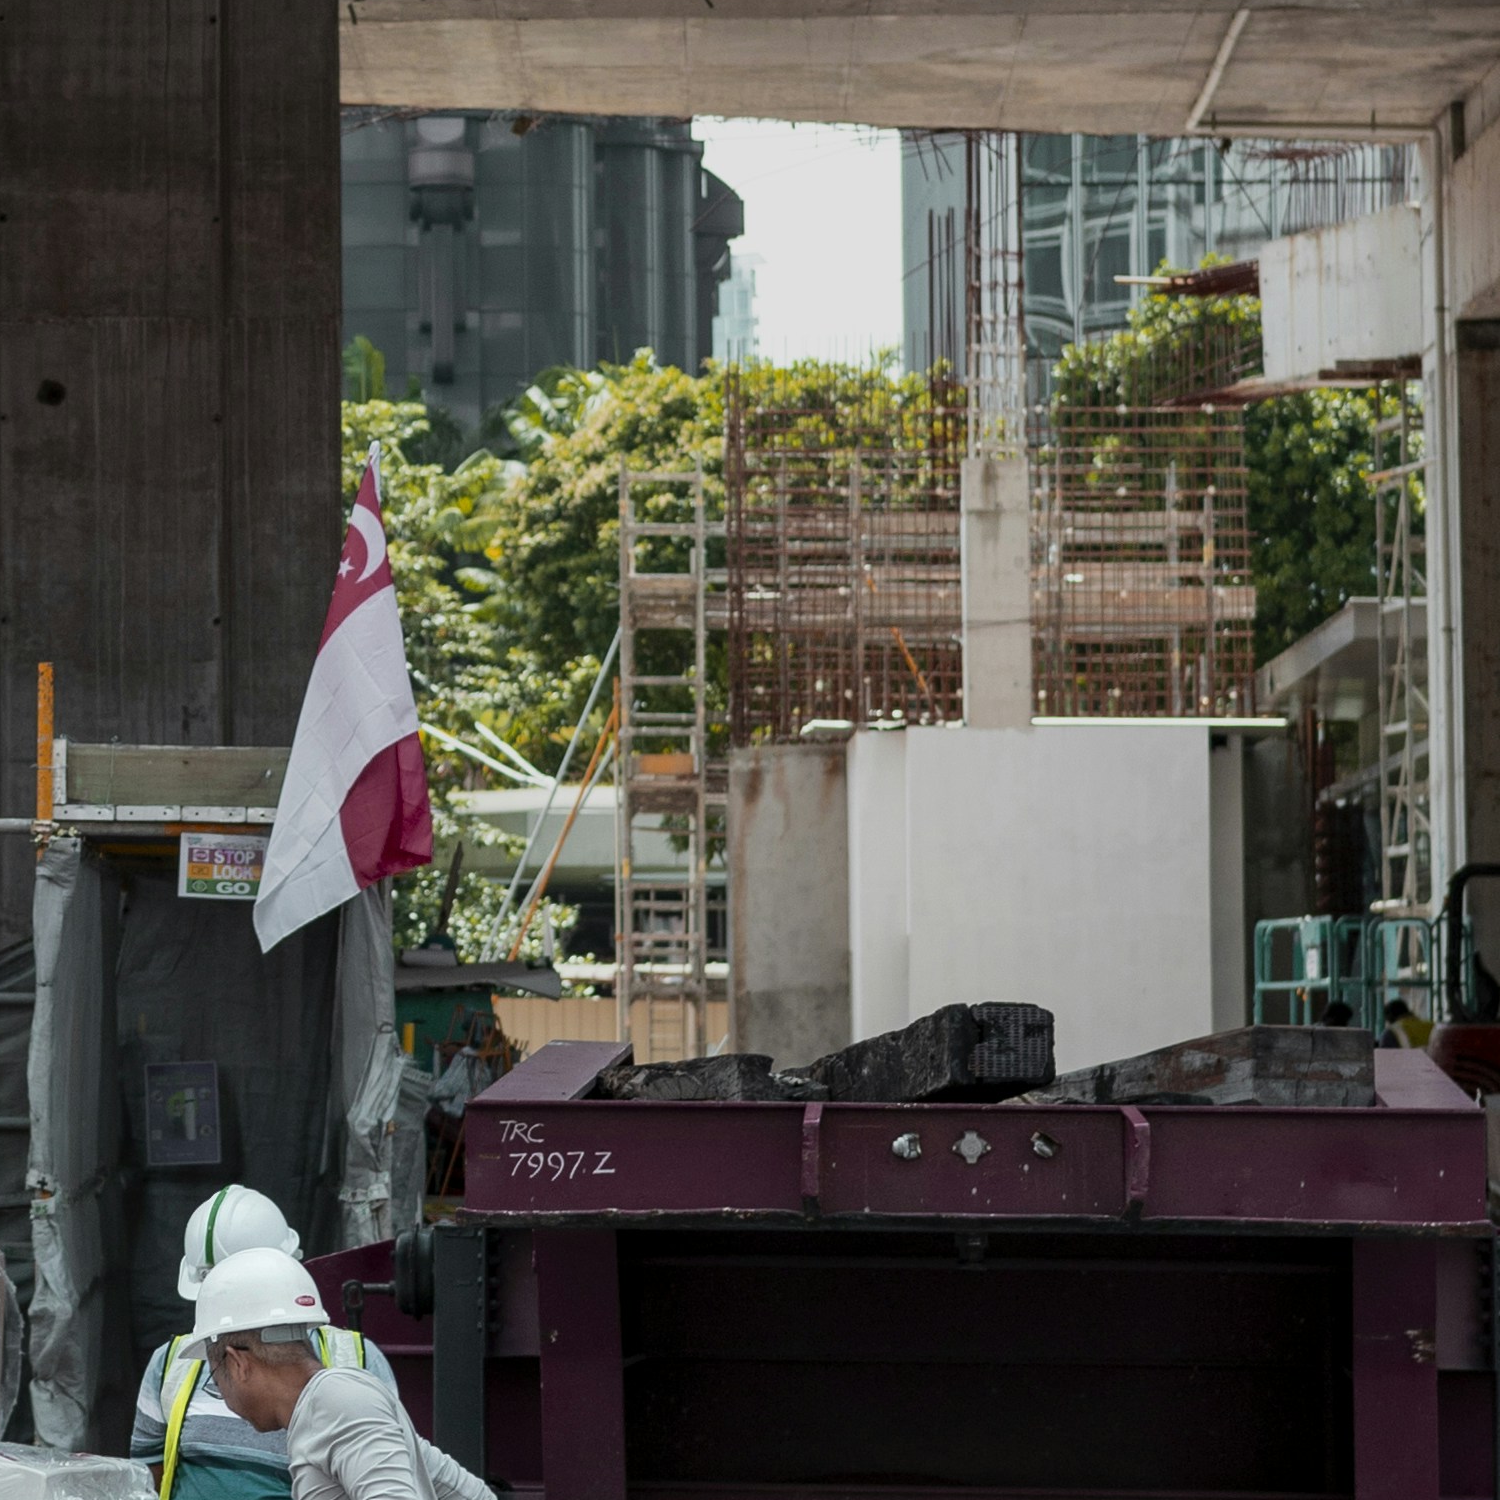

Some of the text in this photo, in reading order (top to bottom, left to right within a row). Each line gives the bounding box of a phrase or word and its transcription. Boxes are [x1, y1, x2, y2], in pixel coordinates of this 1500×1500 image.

[213, 849, 256, 865] STOP
[213, 864, 254, 880] LOOK
[215, 881, 251, 895] GO
[499, 1120, 545, 1143] TRC
